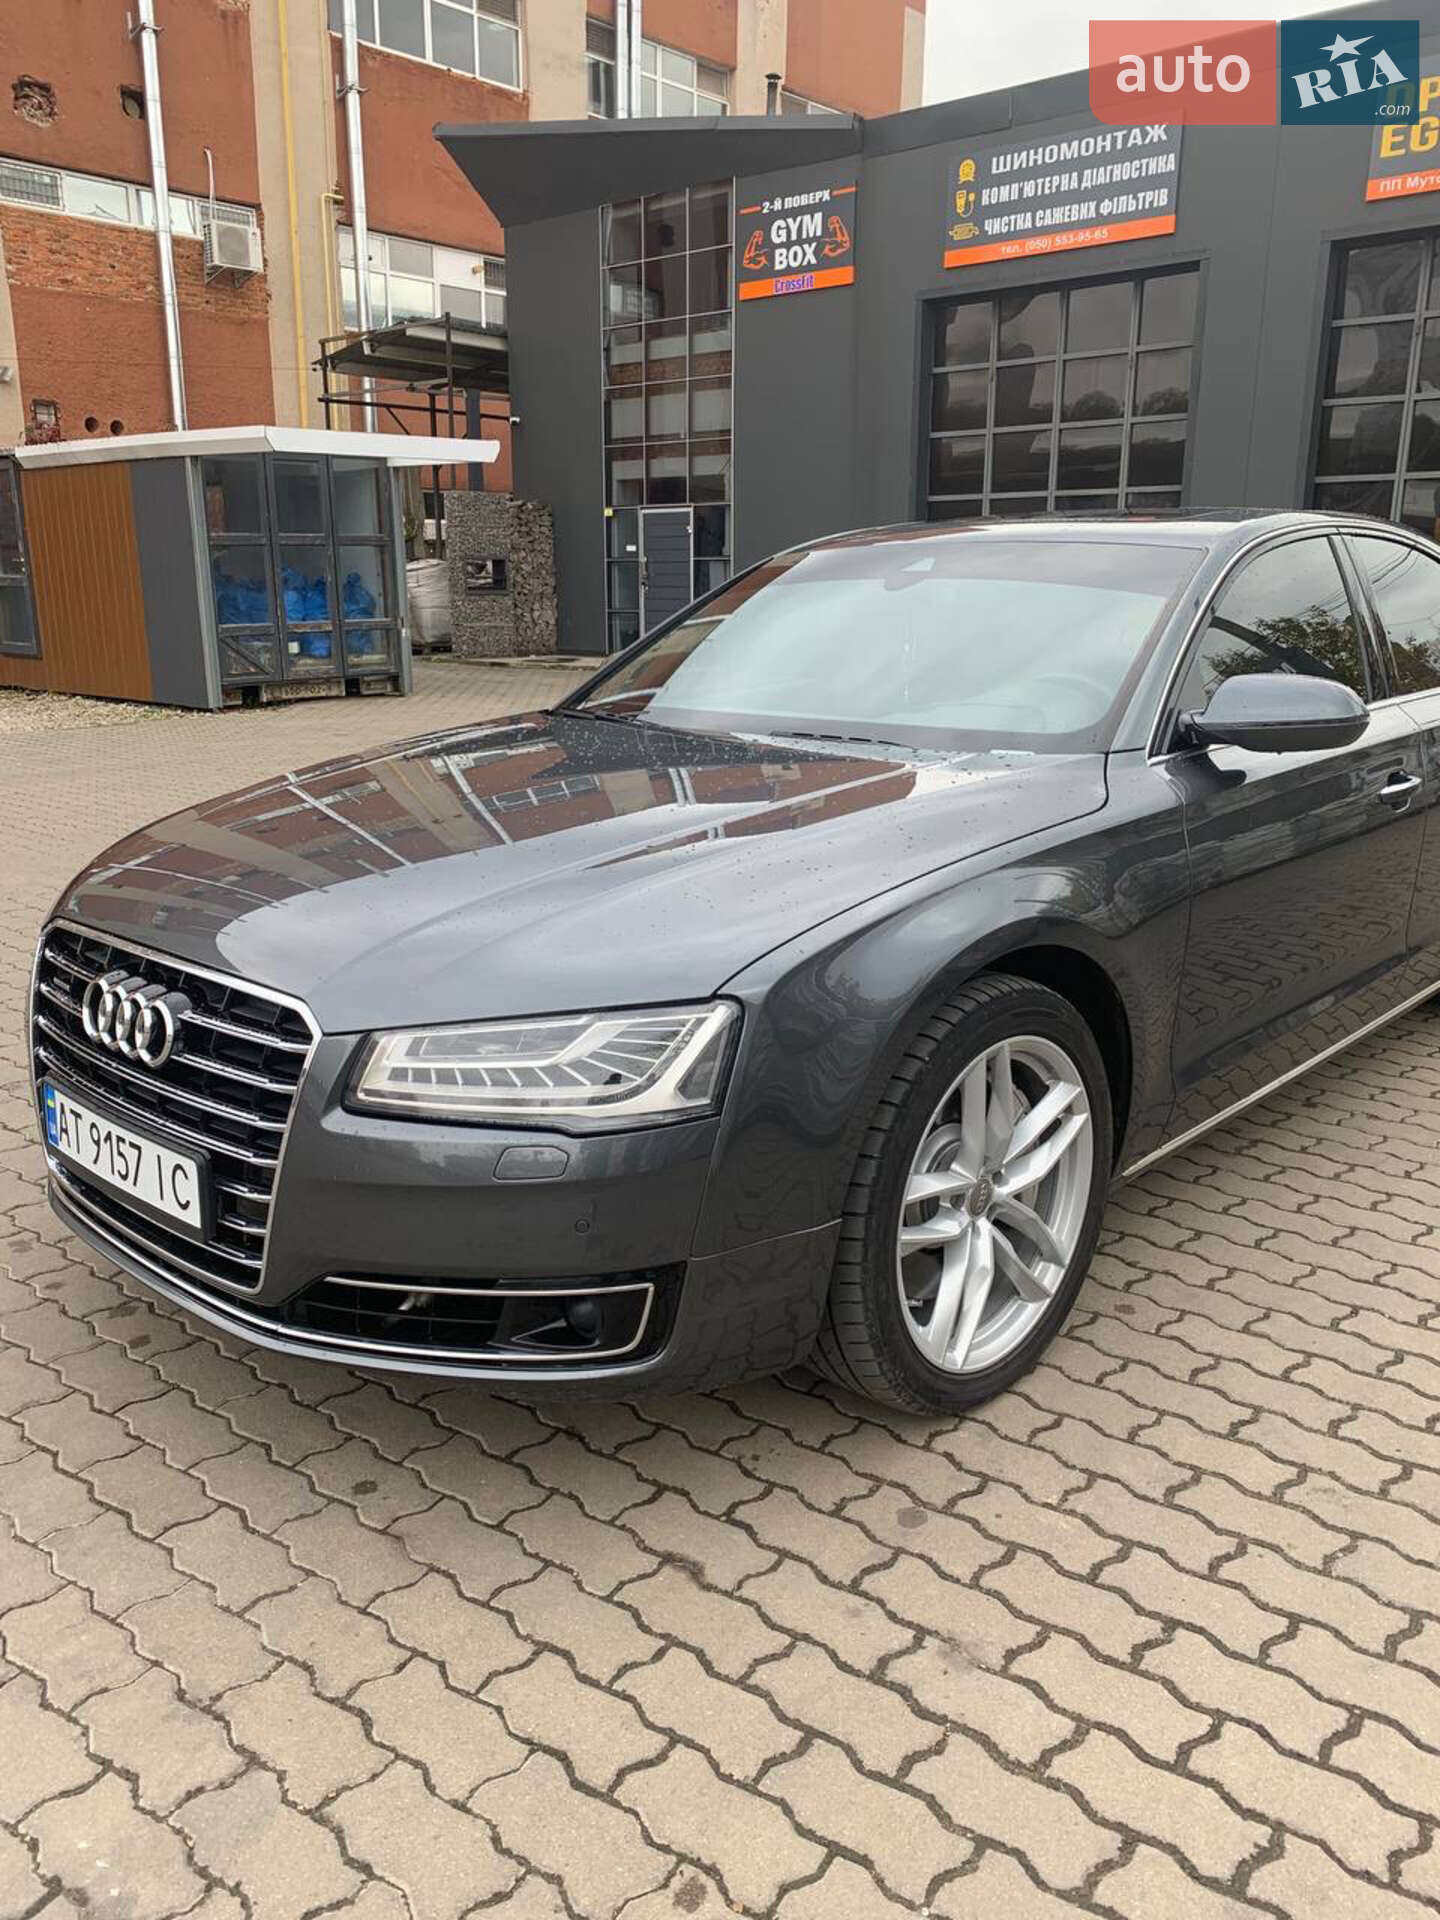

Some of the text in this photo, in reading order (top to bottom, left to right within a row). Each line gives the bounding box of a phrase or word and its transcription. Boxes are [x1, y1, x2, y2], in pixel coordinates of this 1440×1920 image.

[991, 124, 1168, 175] ШИНОМОНТАЖ
[784, 189, 831, 210] ПОВЕРХ
[981, 153, 1176, 206] КОМП'ЮТЕРНА ДІАГНОСТИКА
[771, 211, 823, 244] GYM
[984, 188, 1168, 236] ЧИСТКА САЖЕВИХ ФІЛЬТРІВ
[774, 242, 817, 271] BOX
[60, 1102, 190, 1210] AT 9157 IC
